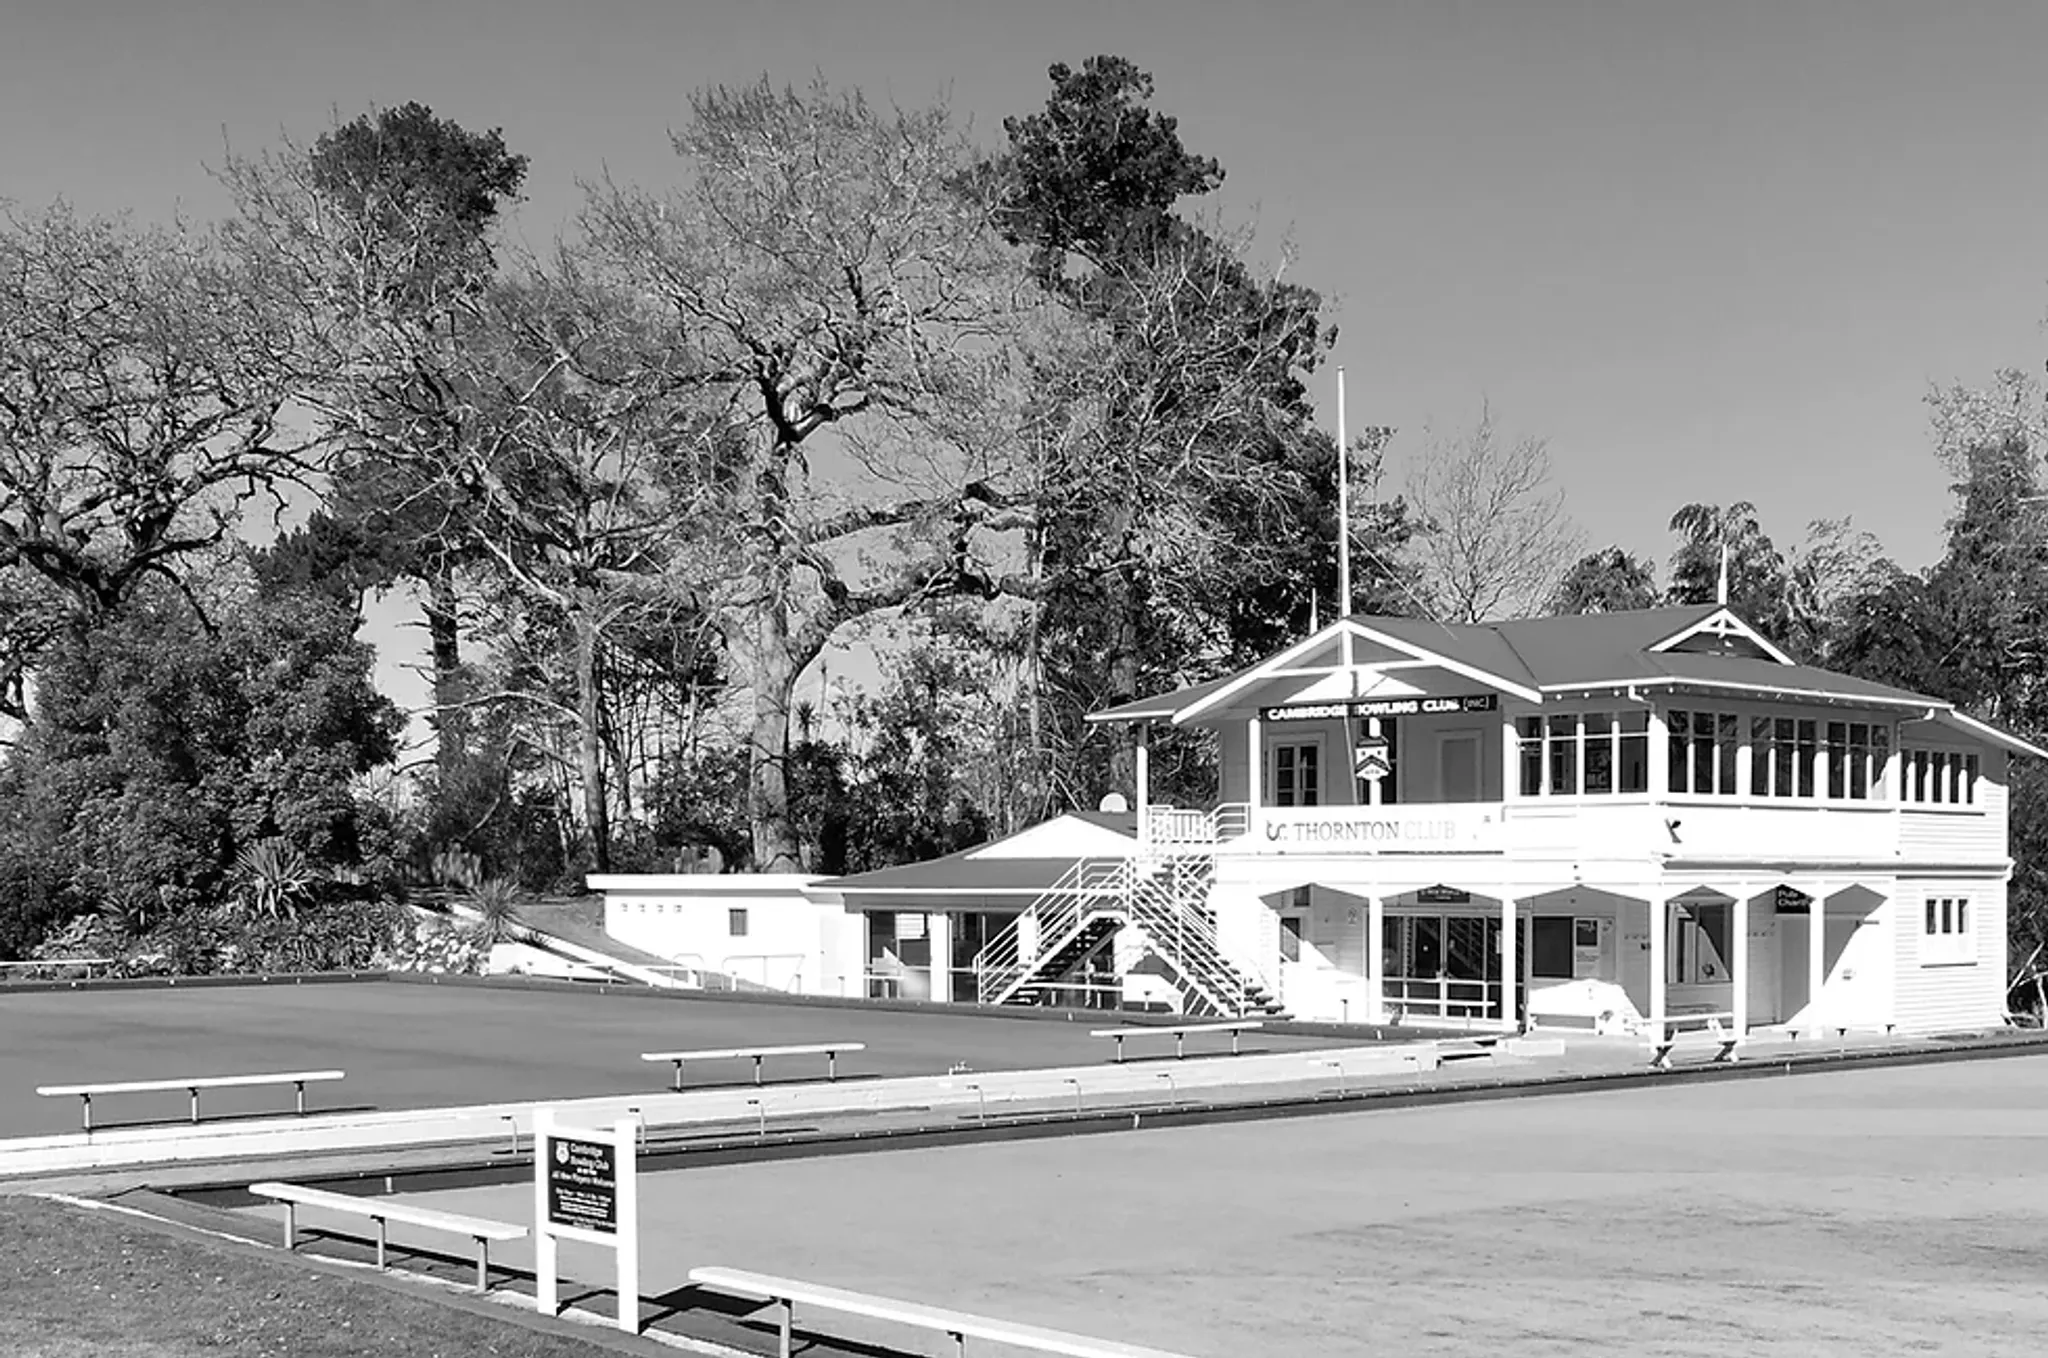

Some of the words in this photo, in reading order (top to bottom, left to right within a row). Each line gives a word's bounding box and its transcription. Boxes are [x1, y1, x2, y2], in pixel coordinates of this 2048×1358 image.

[1268, 703, 1347, 720] CAMBRIDGE
[1422, 699, 1460, 713] CLUB
[1293, 820, 1400, 841] THORNTON
[1404, 820, 1457, 841] CLUB
